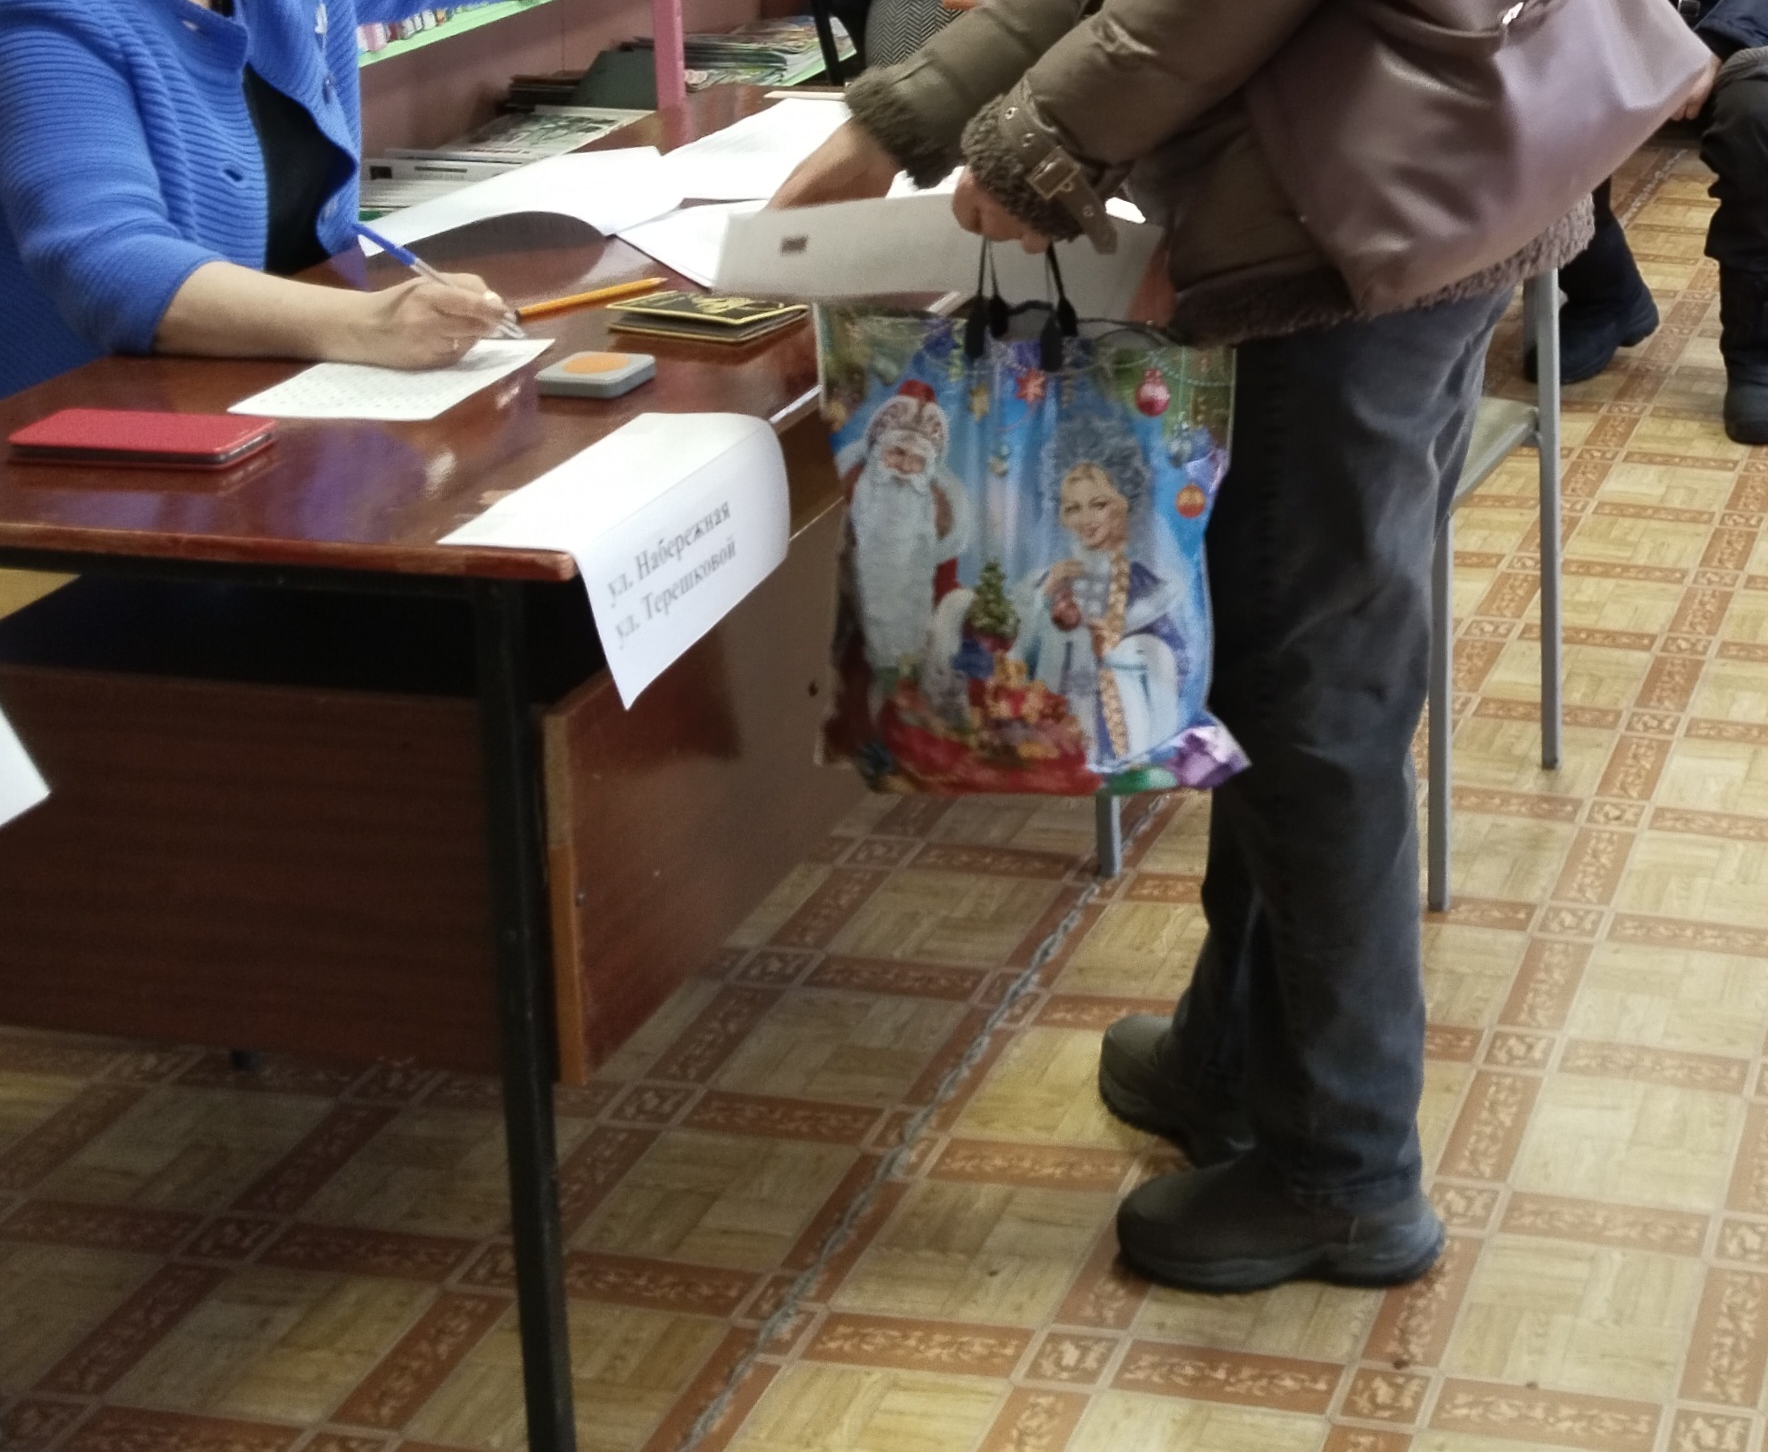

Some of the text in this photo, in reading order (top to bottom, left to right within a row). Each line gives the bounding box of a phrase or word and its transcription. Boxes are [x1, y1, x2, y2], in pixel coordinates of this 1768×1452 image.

[606, 500, 732, 609] ул. Набережная
[615, 536, 737, 650] ул. Терешковой
